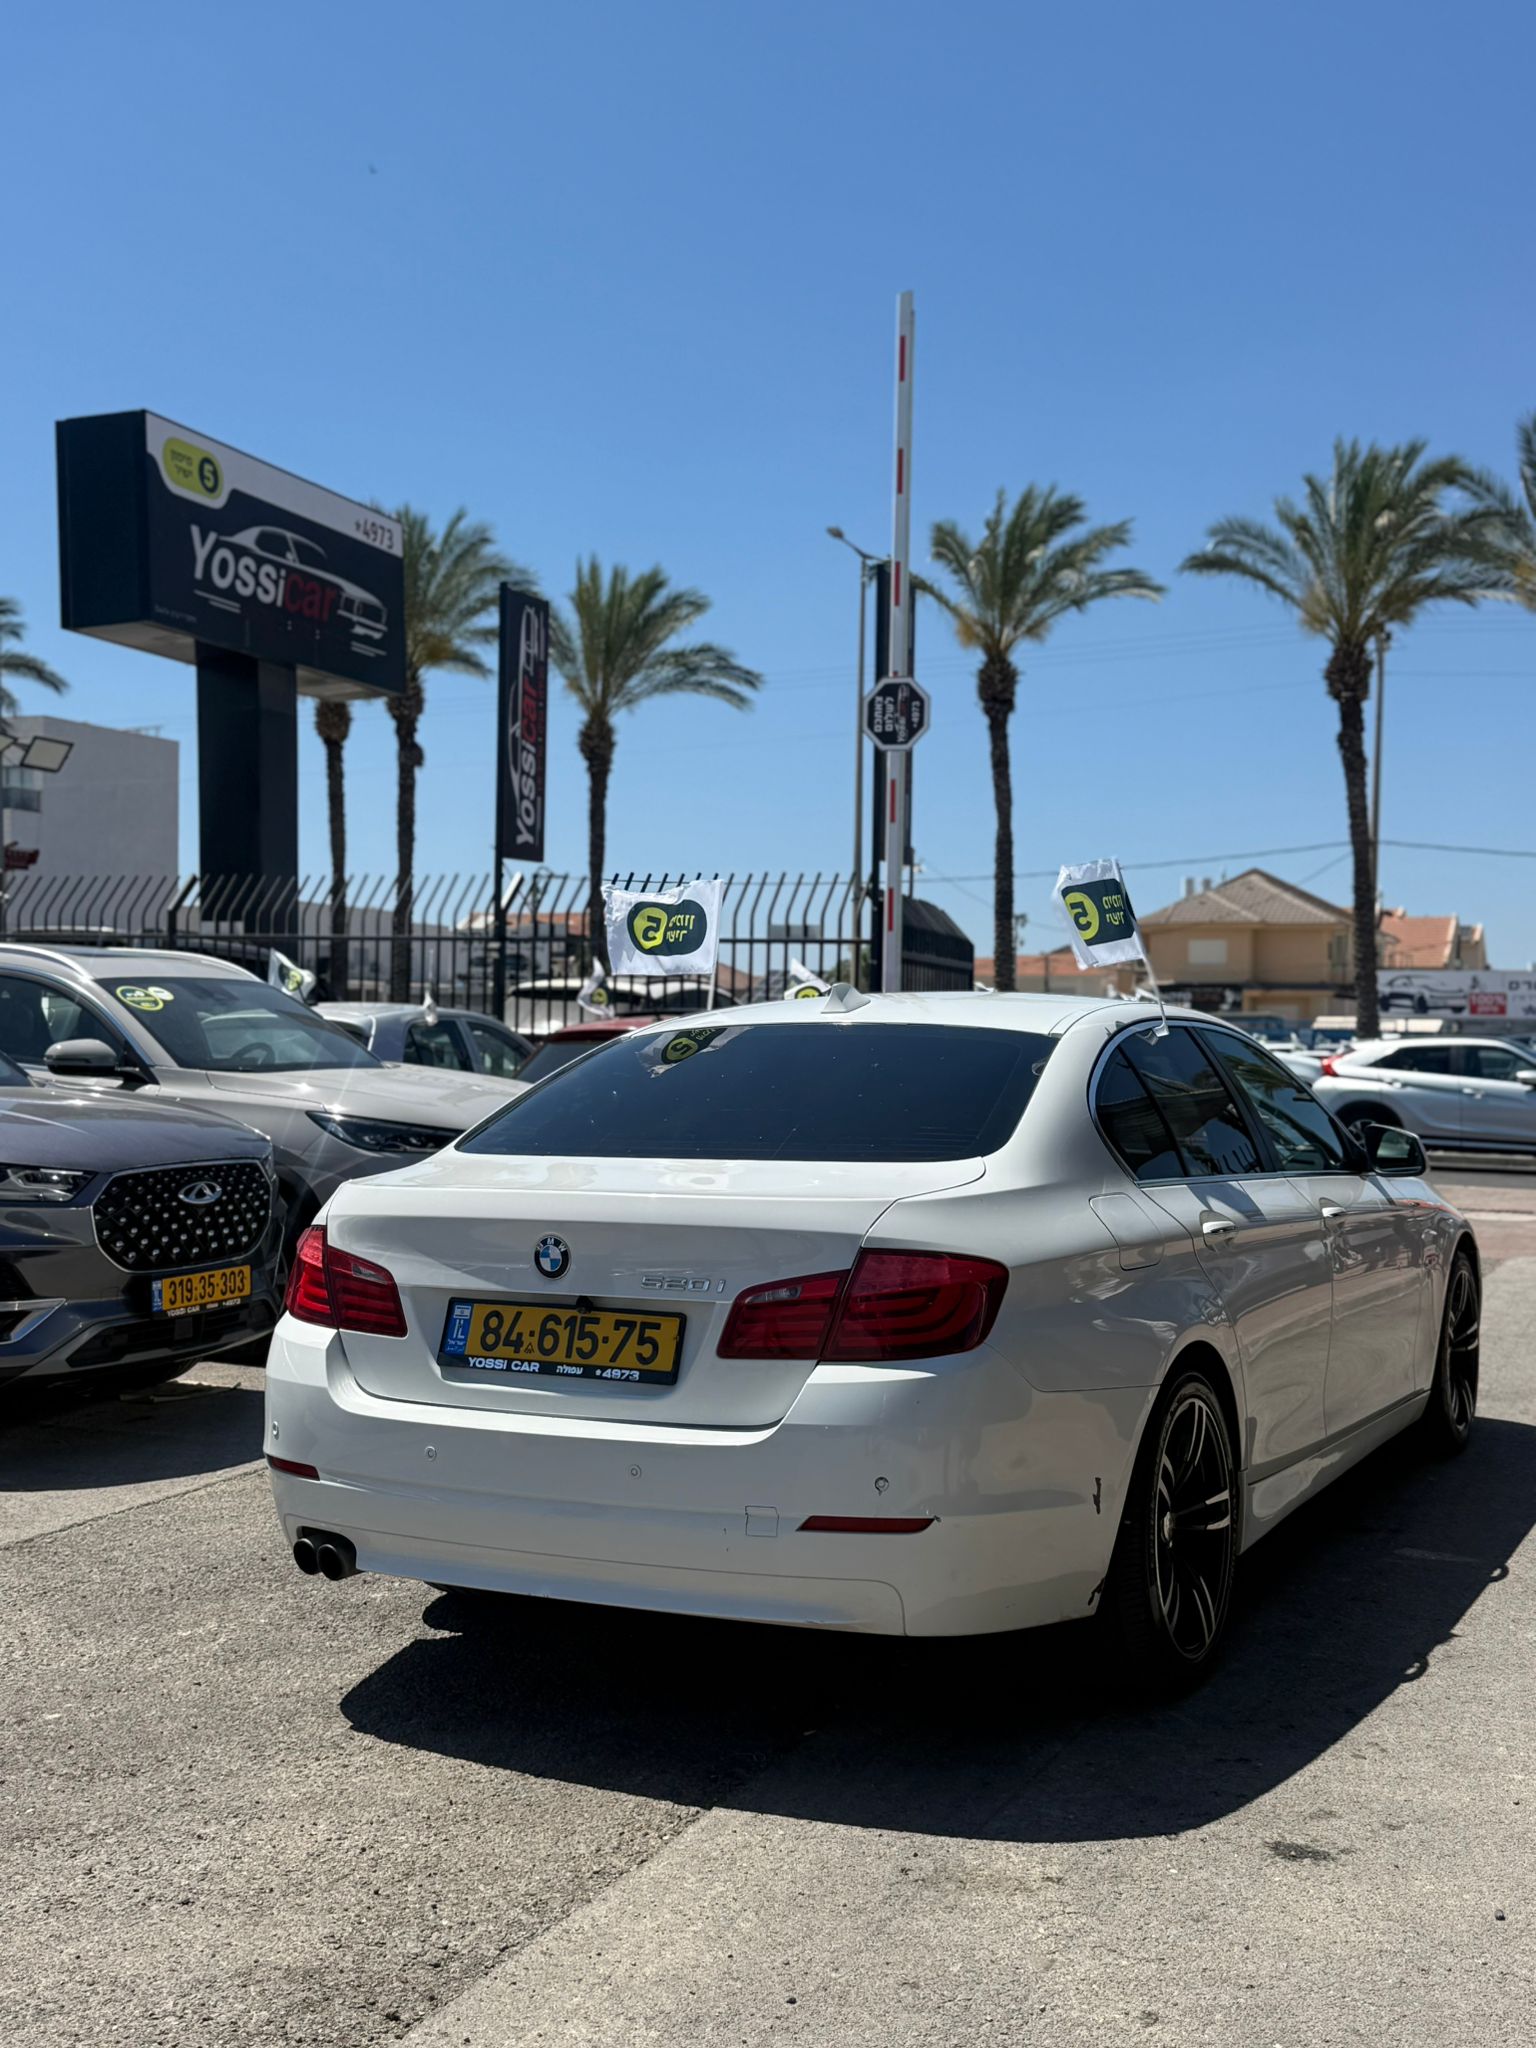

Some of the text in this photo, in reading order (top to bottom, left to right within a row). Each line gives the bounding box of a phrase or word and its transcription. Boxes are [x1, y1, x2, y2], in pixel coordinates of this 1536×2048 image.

[452, 1319, 465, 1339] IL
[468, 1356, 540, 1373] YOSSI CAR
